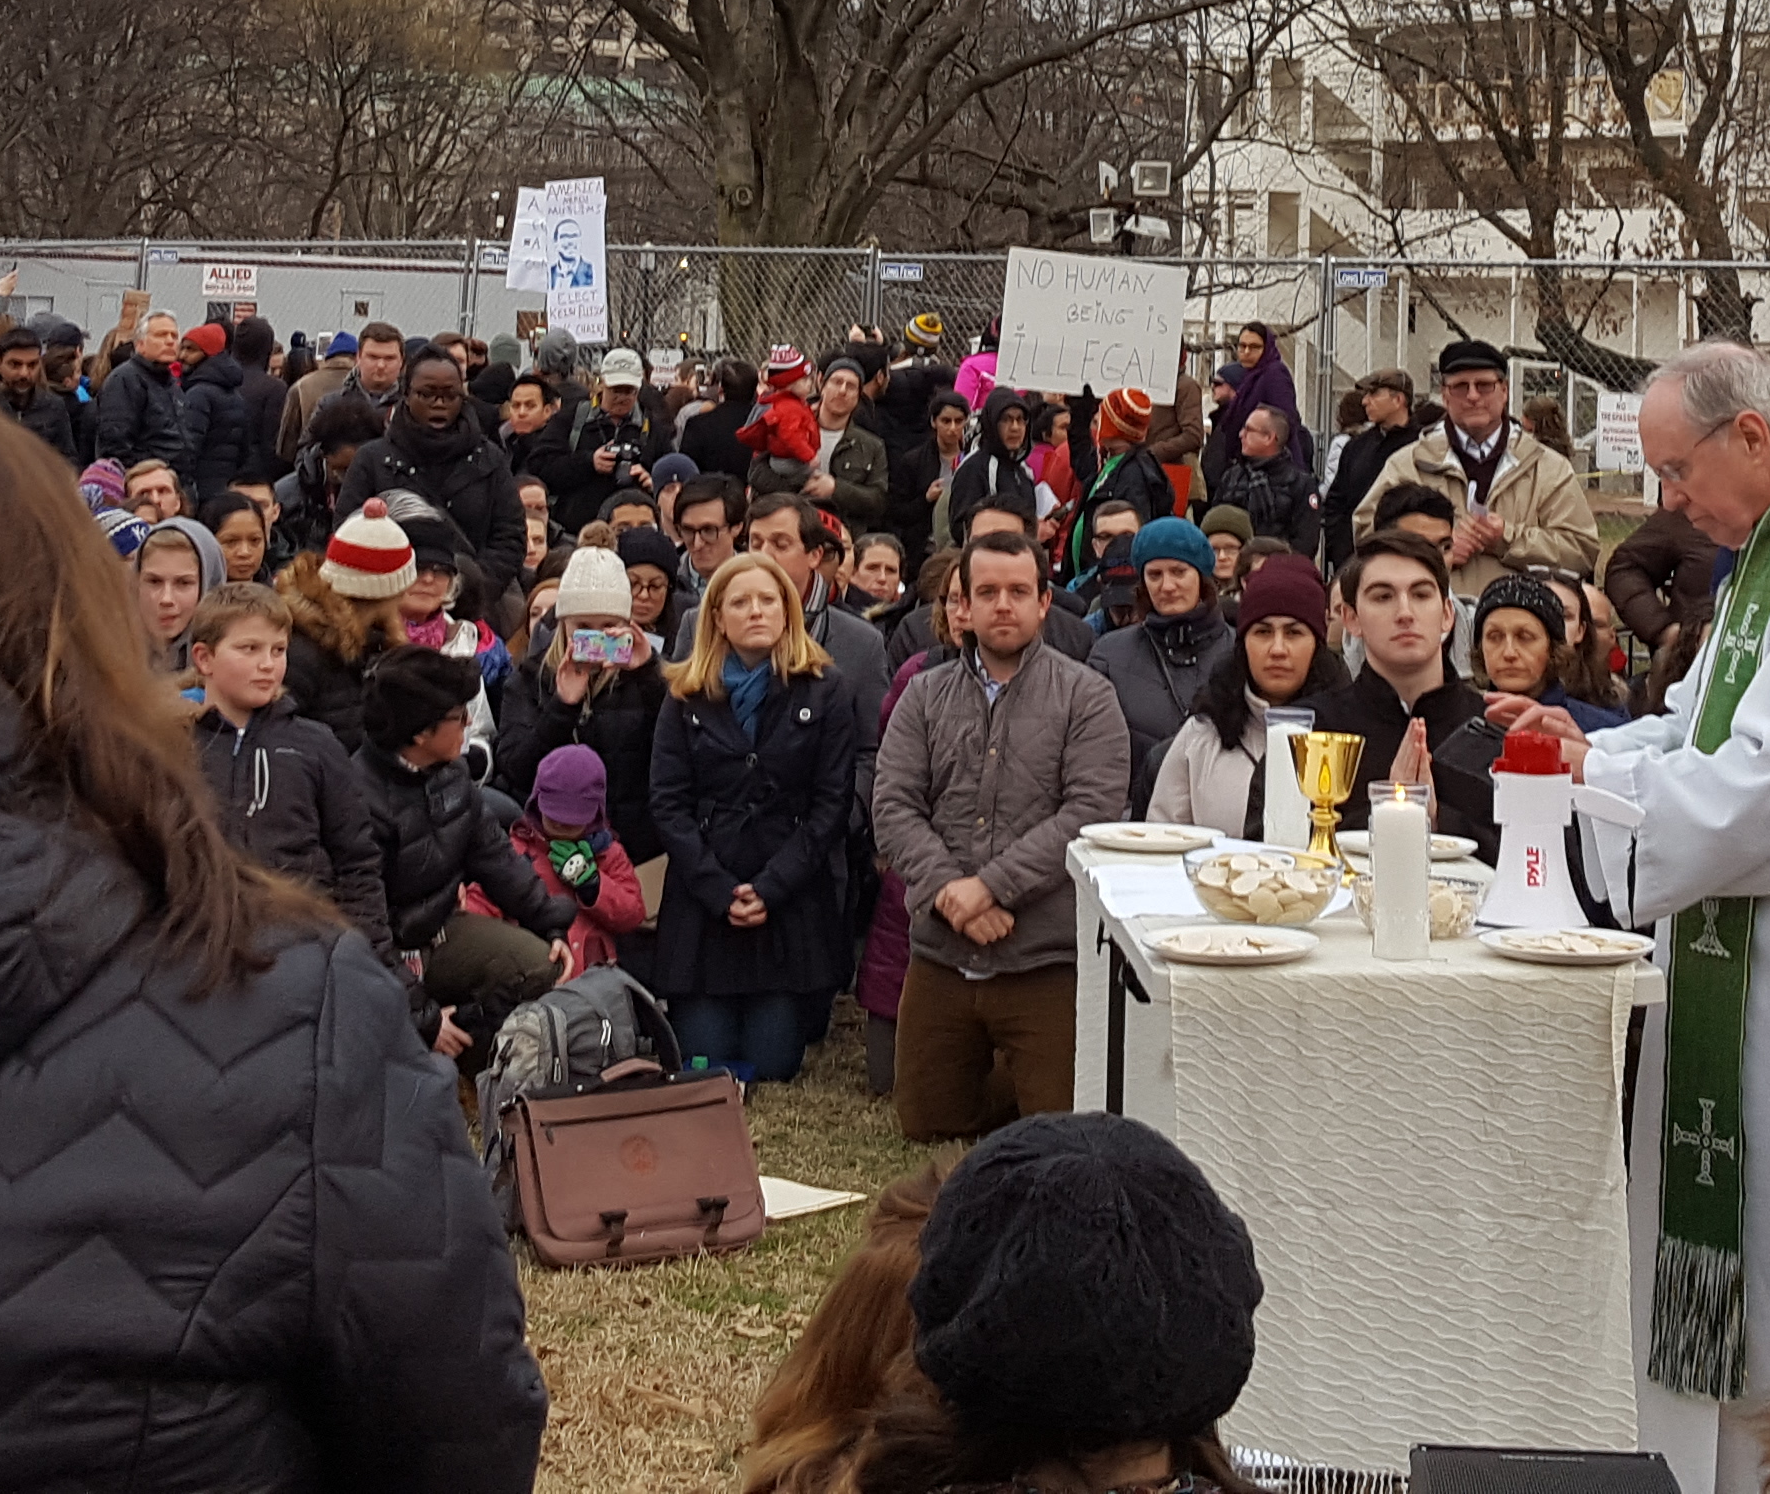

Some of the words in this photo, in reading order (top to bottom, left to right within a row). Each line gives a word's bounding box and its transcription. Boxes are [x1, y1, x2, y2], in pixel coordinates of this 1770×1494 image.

[209, 267, 252, 280] ALLIED
[1017, 258, 1055, 290] NO
[1065, 263, 1155, 295] HUMAN
[557, 290, 597, 305] ELECT
[1527, 847, 1540, 887] PYLE
